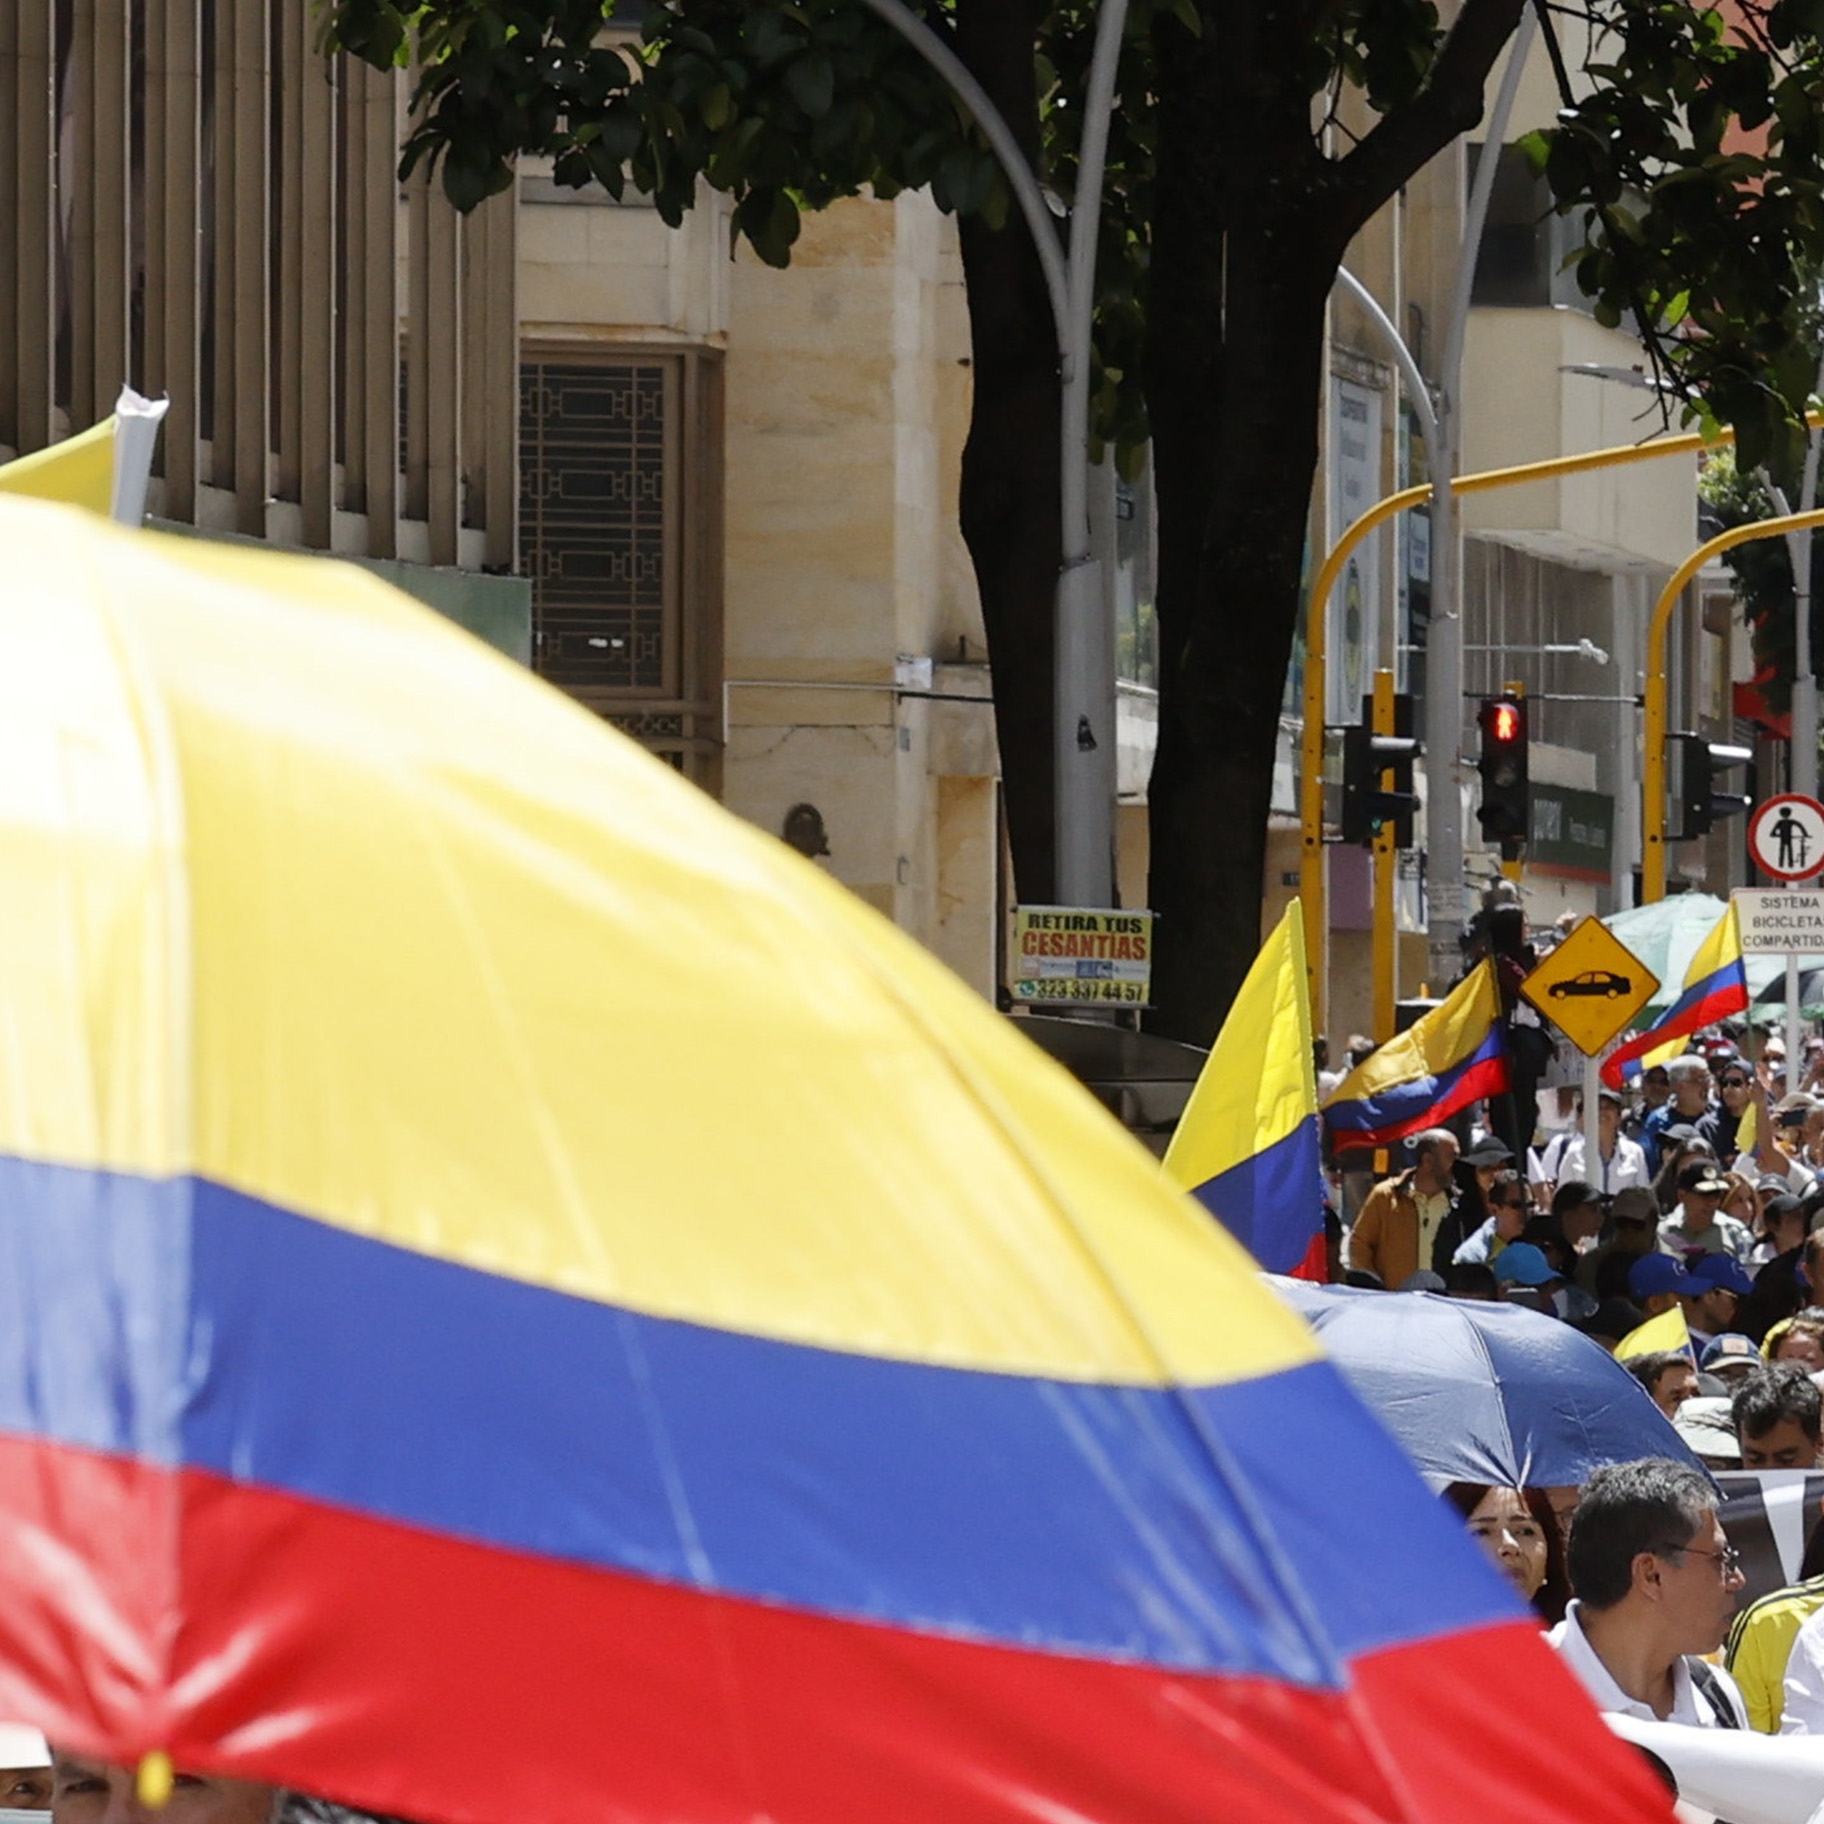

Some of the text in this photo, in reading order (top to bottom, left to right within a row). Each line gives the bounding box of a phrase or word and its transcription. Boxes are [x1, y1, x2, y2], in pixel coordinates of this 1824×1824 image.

[1760, 896, 1820, 909] SISTEMA
[1028, 913, 1143, 934] RETIRA TUS
